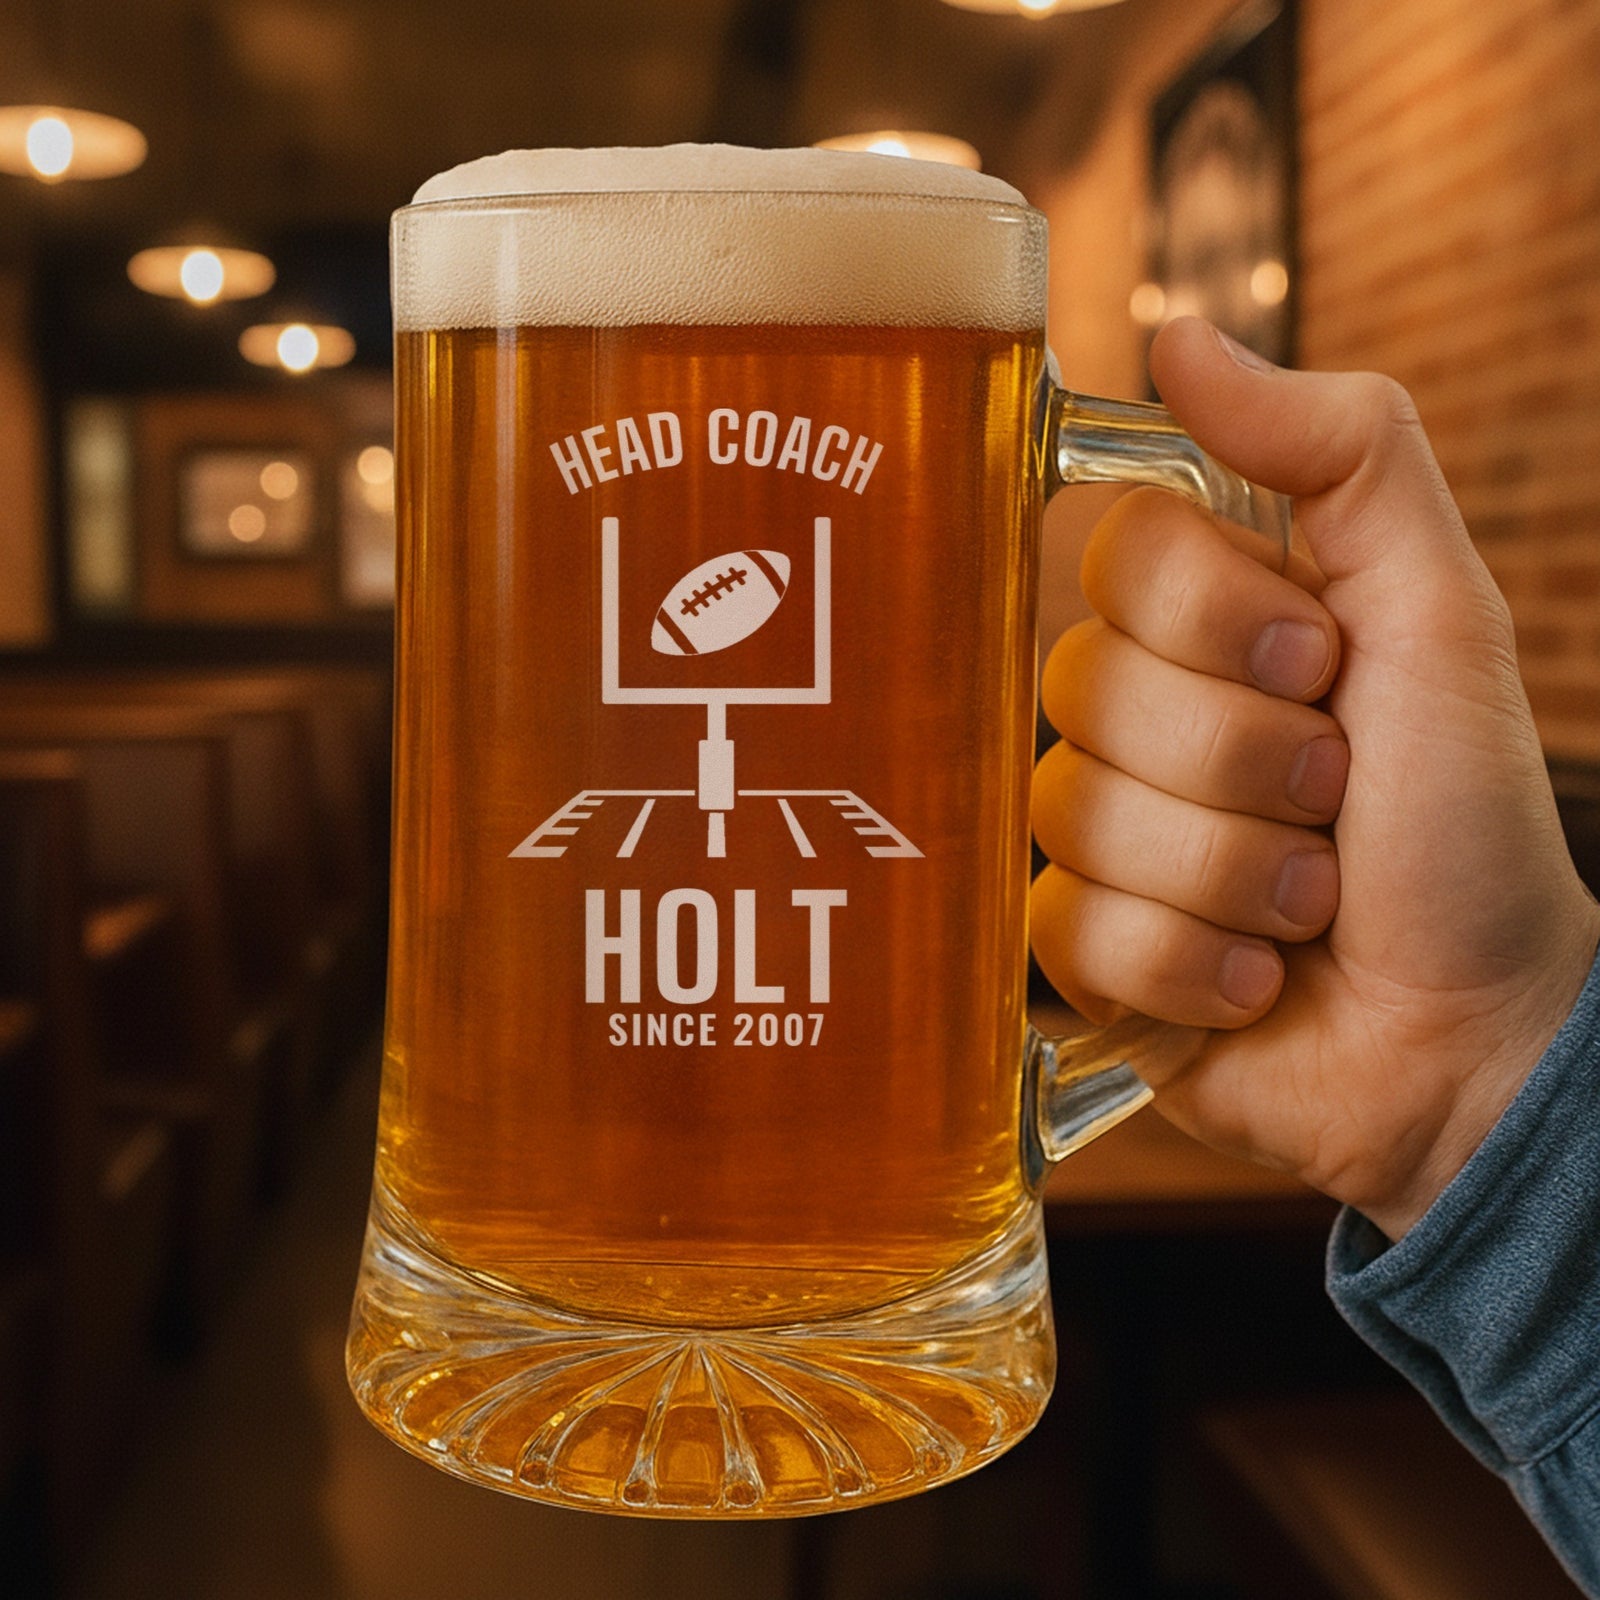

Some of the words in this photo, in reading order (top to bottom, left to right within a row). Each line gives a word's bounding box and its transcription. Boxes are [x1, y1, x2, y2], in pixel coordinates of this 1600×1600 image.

[549, 411, 684, 495] HEAD
[708, 408, 884, 495] COACH
[585, 888, 848, 1005] HOLT
[608, 1013, 717, 1047] SINCE
[733, 1013, 825, 1047] 2007
